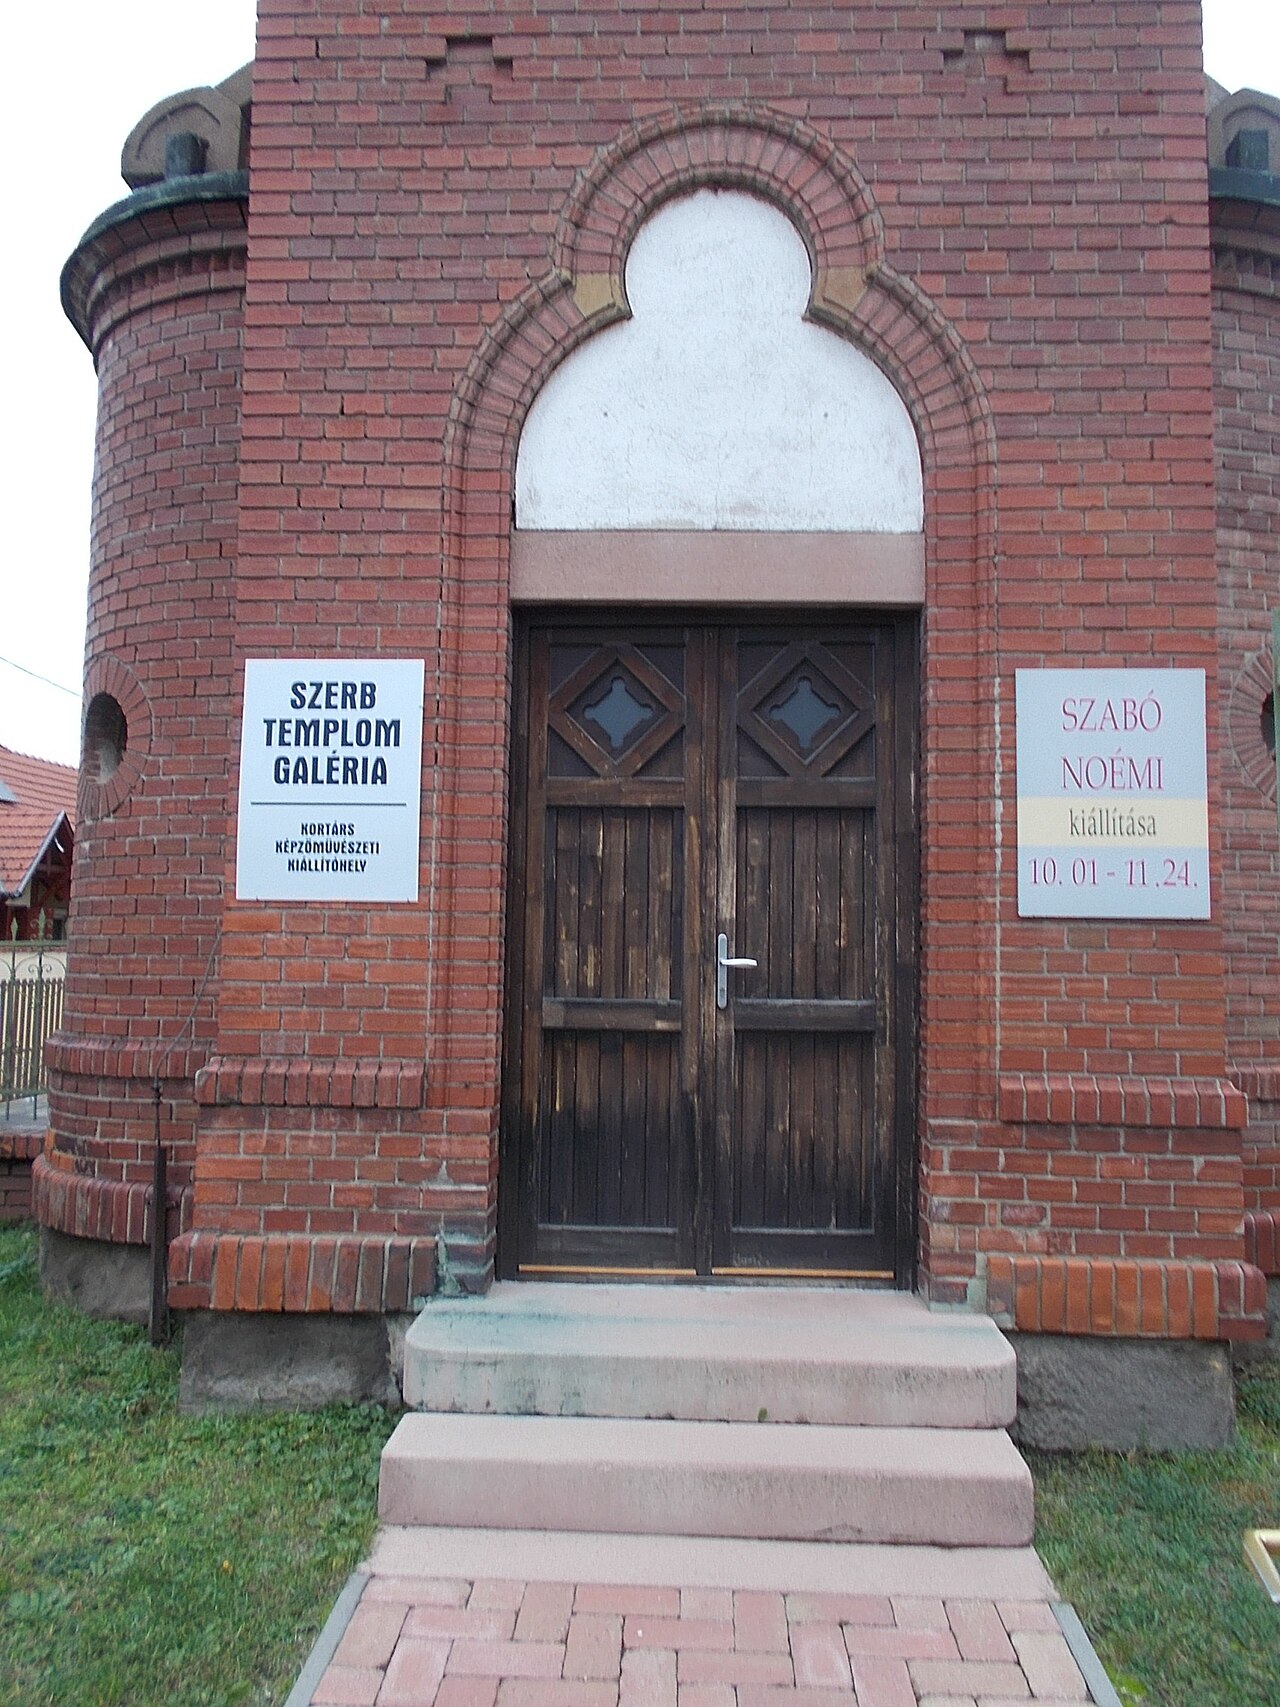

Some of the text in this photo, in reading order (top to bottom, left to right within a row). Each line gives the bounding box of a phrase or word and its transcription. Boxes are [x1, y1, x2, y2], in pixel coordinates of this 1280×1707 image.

[290, 681, 377, 710] SZERB
[1062, 689, 1163, 732] SZABÓ
[263, 718, 401, 748] TEMPLOM
[273, 749, 388, 785] GALÉRIA
[1061, 747, 1164, 790] NOÉMI
[300, 820, 355, 836] KORTÁRS
[1069, 807, 1157, 837] kiállítása
[287, 856, 367, 872] KIÁLLÍTÓHELY
